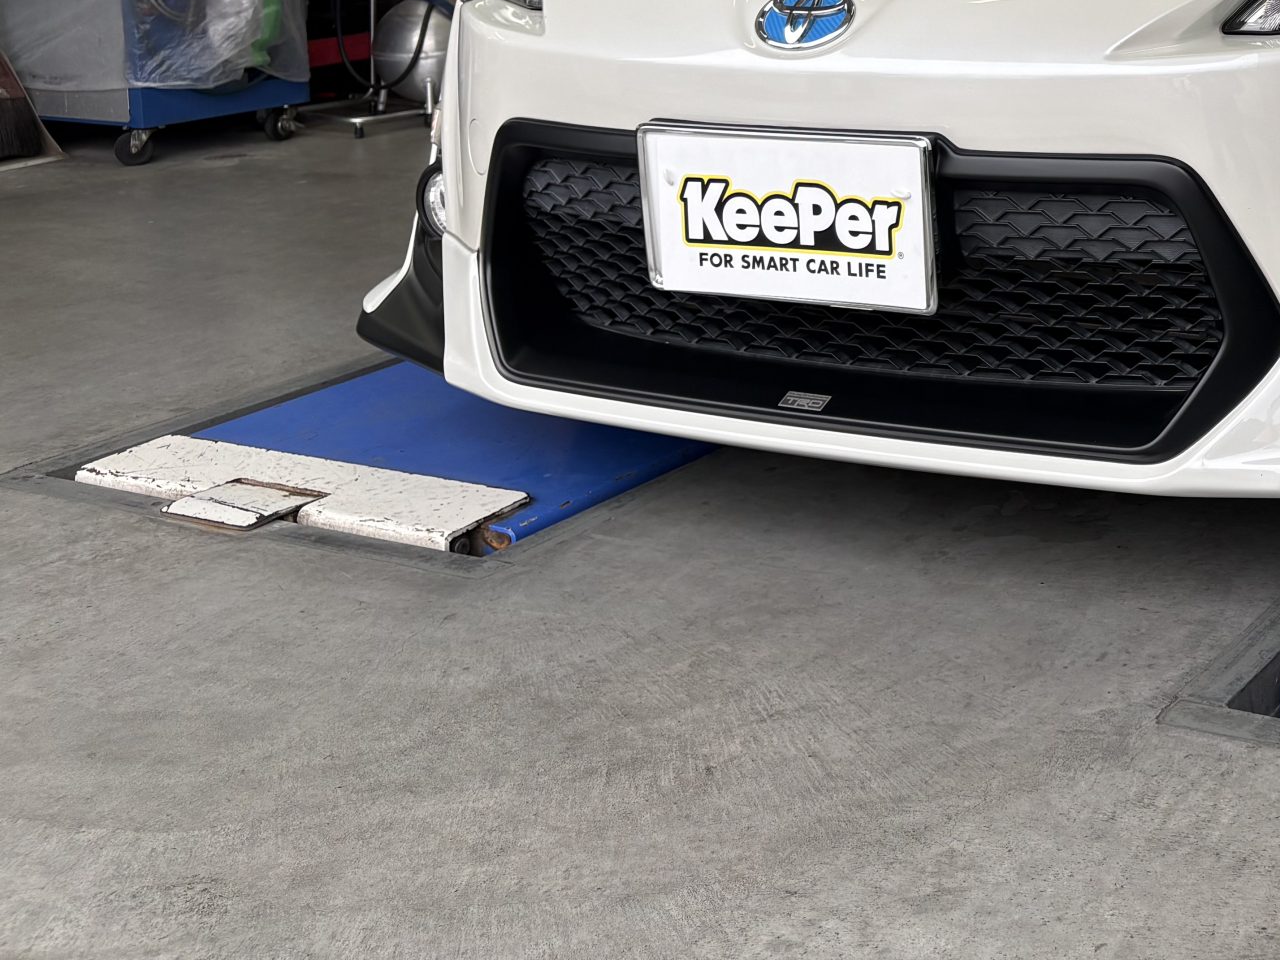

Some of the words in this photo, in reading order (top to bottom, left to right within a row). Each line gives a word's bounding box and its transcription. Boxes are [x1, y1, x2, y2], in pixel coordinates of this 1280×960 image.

[681, 176, 903, 255] KeePer
[699, 252, 734, 268] FOR
[741, 254, 800, 273] SMART
[806, 258, 840, 276] CAR
[847, 261, 887, 279] LIFE
[784, 395, 825, 409] TRD
